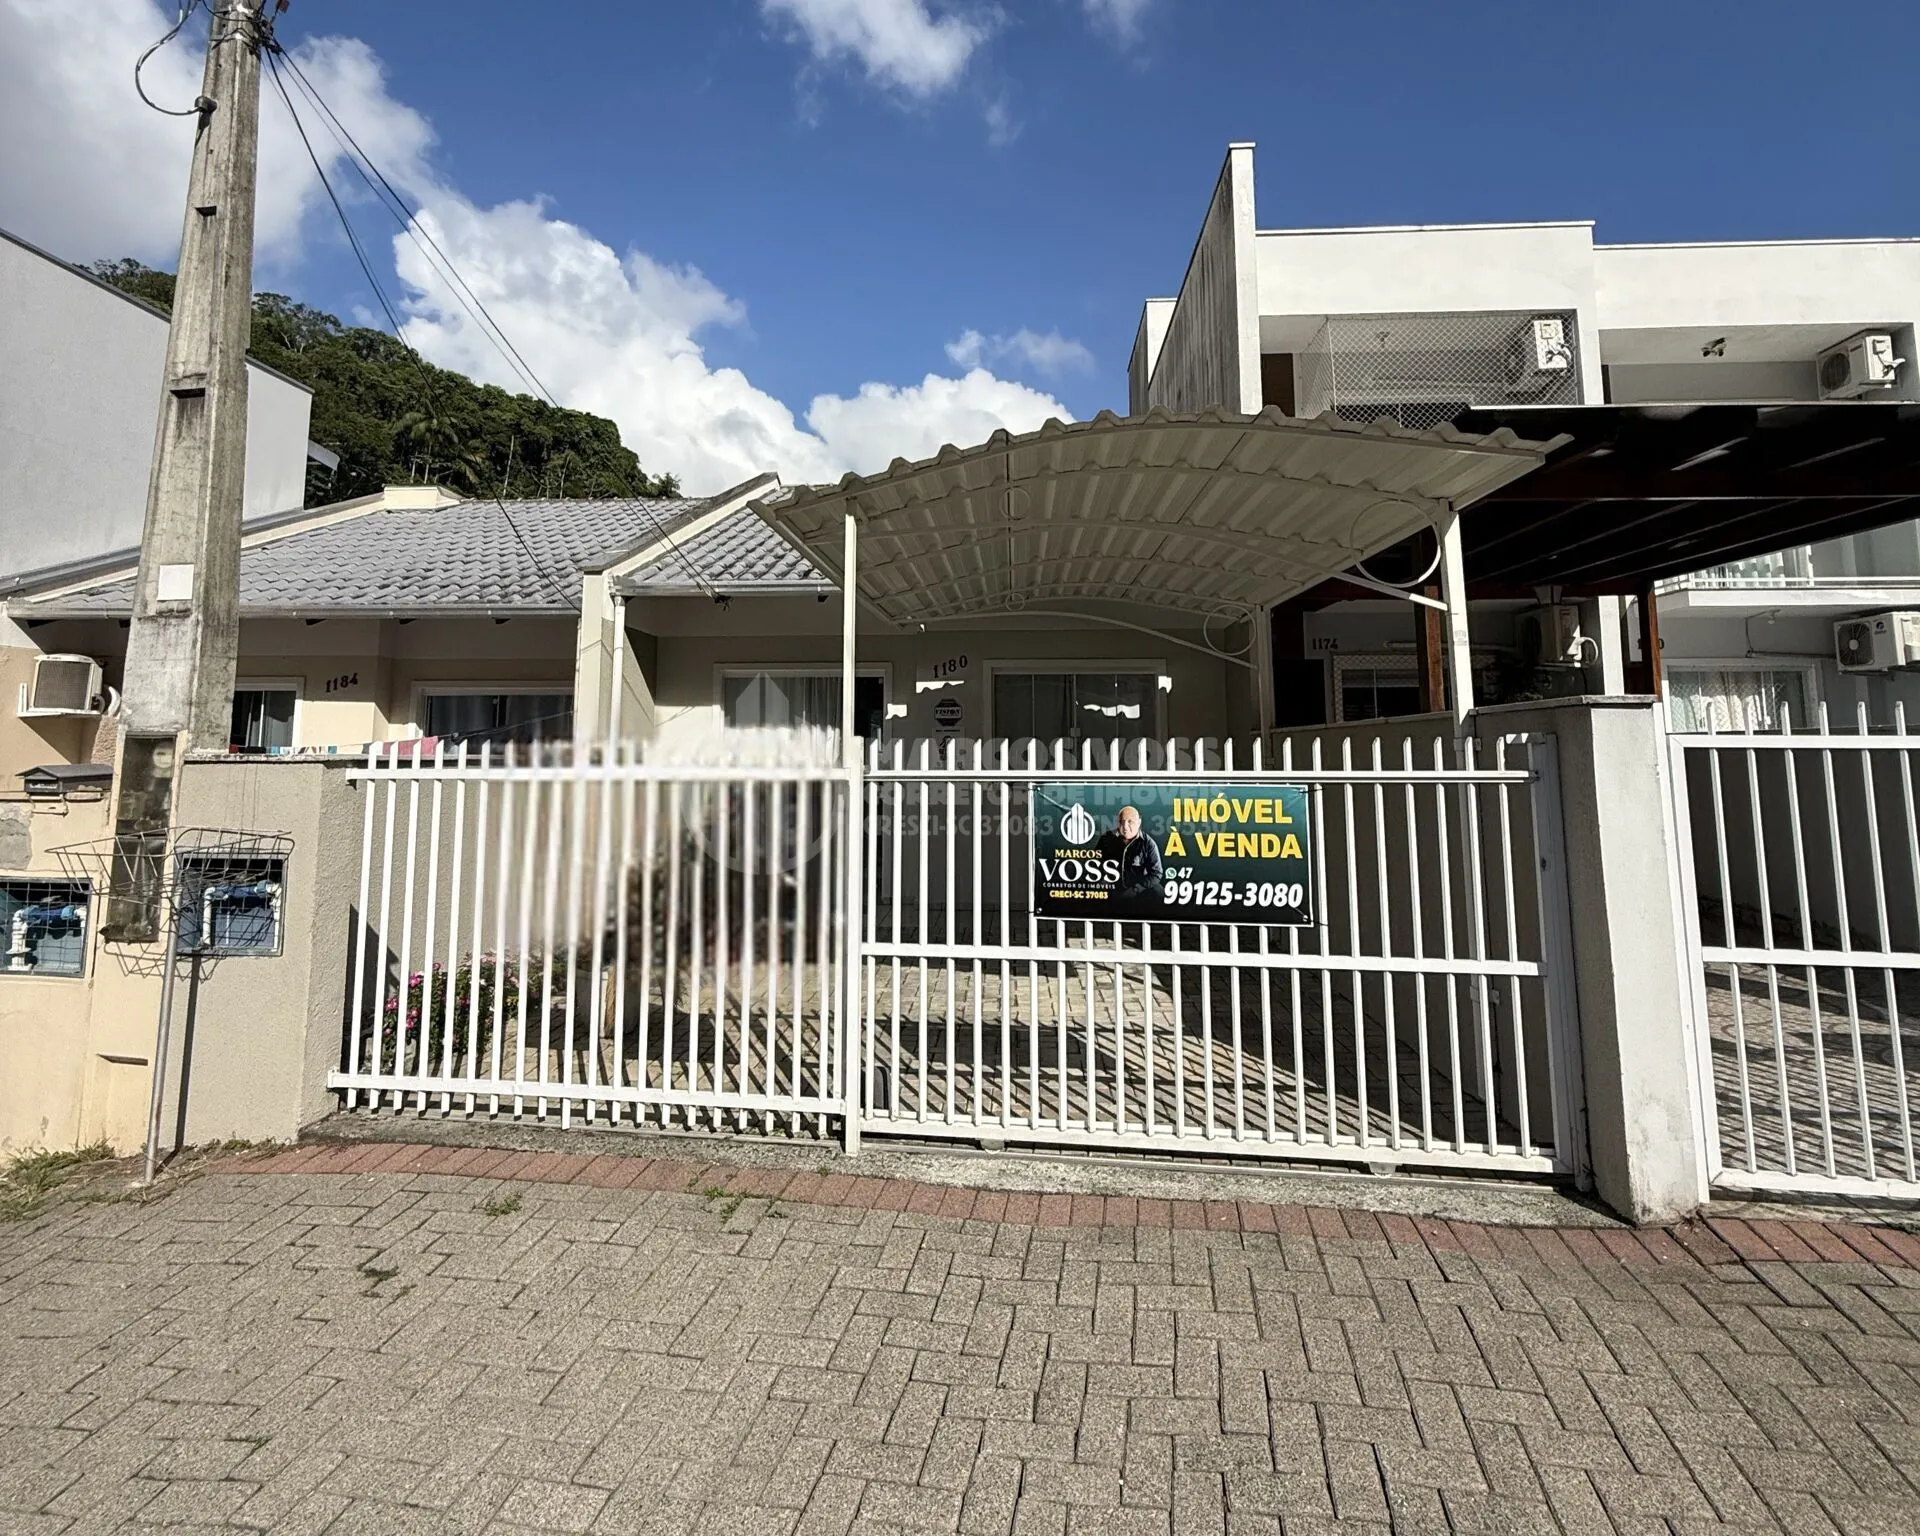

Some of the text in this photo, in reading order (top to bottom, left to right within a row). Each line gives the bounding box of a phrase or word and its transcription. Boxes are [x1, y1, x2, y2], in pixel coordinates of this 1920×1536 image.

[934, 655, 968, 678] 1180
[326, 672, 358, 693] 1184
[1173, 793, 1293, 824] IMÓVEL
[1054, 849, 1103, 859] MARCOS
[1164, 826, 1187, 857] À
[1194, 832, 1303, 859] VENDA
[1038, 858, 1121, 883] VOSS
[1178, 867, 1193, 879] 47
[1049, 890, 1109, 900] CRECI-SC 37083
[1164, 880, 1304, 908] 99125-3080
